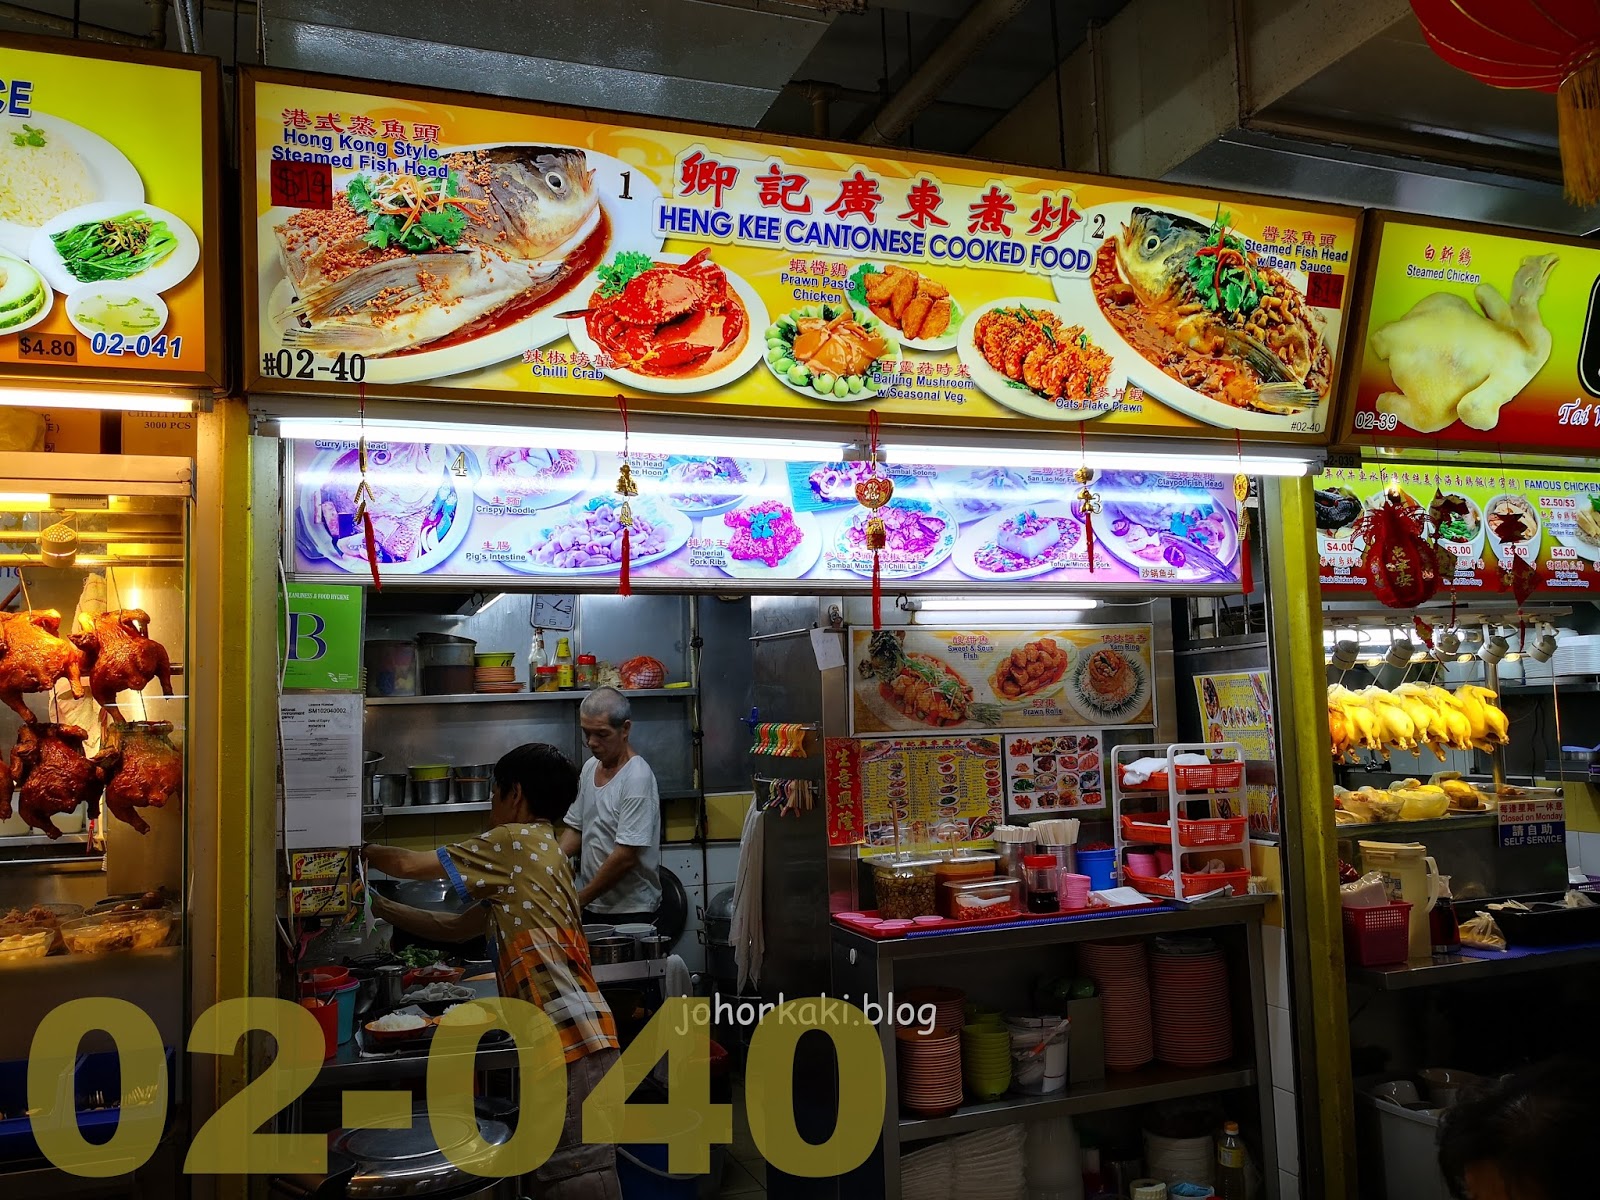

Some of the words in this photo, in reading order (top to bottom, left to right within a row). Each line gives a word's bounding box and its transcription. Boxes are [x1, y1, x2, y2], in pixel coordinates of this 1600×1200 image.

[0, 78, 33, 117] E
[281, 108, 441, 145] 港式蒸魚頭
[283, 128, 332, 151] Hong
[339, 135, 387, 157] Kong
[394, 141, 438, 161] Style
[272, 146, 353, 168] Steamed
[359, 155, 398, 173] Fish
[404, 162, 448, 178] Head
[618, 171, 633, 200] 1
[679, 151, 1082, 243] 卿記廣東煮炒
[1092, 214, 1106, 239] 2
[659, 206, 732, 236] HENG
[738, 214, 781, 240] KEE
[785, 219, 924, 255] CANTONESE
[930, 234, 1025, 264] COOKED
[1031, 244, 1092, 271] FOOD
[1244, 239, 1292, 255] Steamed
[1295, 245, 1318, 259] Fish
[1321, 250, 1348, 262] Head
[1256, 256, 1296, 270] w/Bean
[1300, 260, 1332, 273] Sauce
[781, 273, 818, 287] Prawn
[823, 277, 856, 290] Paste
[1407, 264, 1444, 280] Steamed
[1446, 269, 1480, 284] Chicken
[793, 289, 841, 303] Chicken
[20, 336, 75, 357] $4.80
[91, 332, 183, 359] 02-041
[262, 349, 366, 383] #02-40
[532, 364, 568, 378] Chilli
[573, 367, 605, 381] Crab
[873, 373, 912, 388] Bailing
[916, 376, 974, 390] Mushroom
[877, 387, 941, 401] w/Seasonal
[944, 391, 967, 404] Veg.
[1055, 398, 1079, 410] Oats
[1082, 399, 1109, 411] Flake
[1112, 401, 1142, 413] Prawn
[1558, 398, 1589, 425] Tai
[144, 421, 167, 429] 3000
[170, 422, 191, 430] PCS
[1290, 421, 1321, 433] #02-40
[1355, 412, 1397, 430] 02-39
[314, 439, 340, 449] Curry
[451, 451, 468, 477] 4
[643, 460, 663, 468] Head
[886, 468, 911, 476] Sambal
[913, 470, 937, 478] Sotong
[1157, 478, 1186, 487] Claypot
[1187, 479, 1203, 487] Fish
[1204, 480, 1223, 488] Head
[1525, 480, 1562, 490] FAMOUS
[1564, 481, 1600, 491] CHICKEN
[476, 505, 503, 516] Crispy
[506, 506, 535, 514] Noodle
[692, 550, 723, 558] Imperial
[1327, 542, 1353, 551] $4.00
[1504, 547, 1527, 556] $300
[1553, 548, 1575, 557] $4.00
[466, 552, 487, 561] Pig's
[489, 553, 526, 561] Intestine
[690, 558, 708, 566] Pork
[827, 562, 853, 570] Sambal
[855, 562, 884, 570] Musss
[1142, 569, 1175, 578] 沙锅鱼头
[288, 591, 313, 599] LEANLINESS
[288, 612, 327, 661] B
[1125, 643, 1140, 651] Ring
[833, 748, 856, 831] 生意興隆
[1500, 801, 1563, 813] 每逢星期一休息
[1501, 814, 1525, 823] Closed
[1535, 812, 1563, 822] Monday
[1512, 824, 1552, 836] 請自助
[1504, 837, 1525, 846] SELF
[1527, 835, 1562, 845] SERVICE
